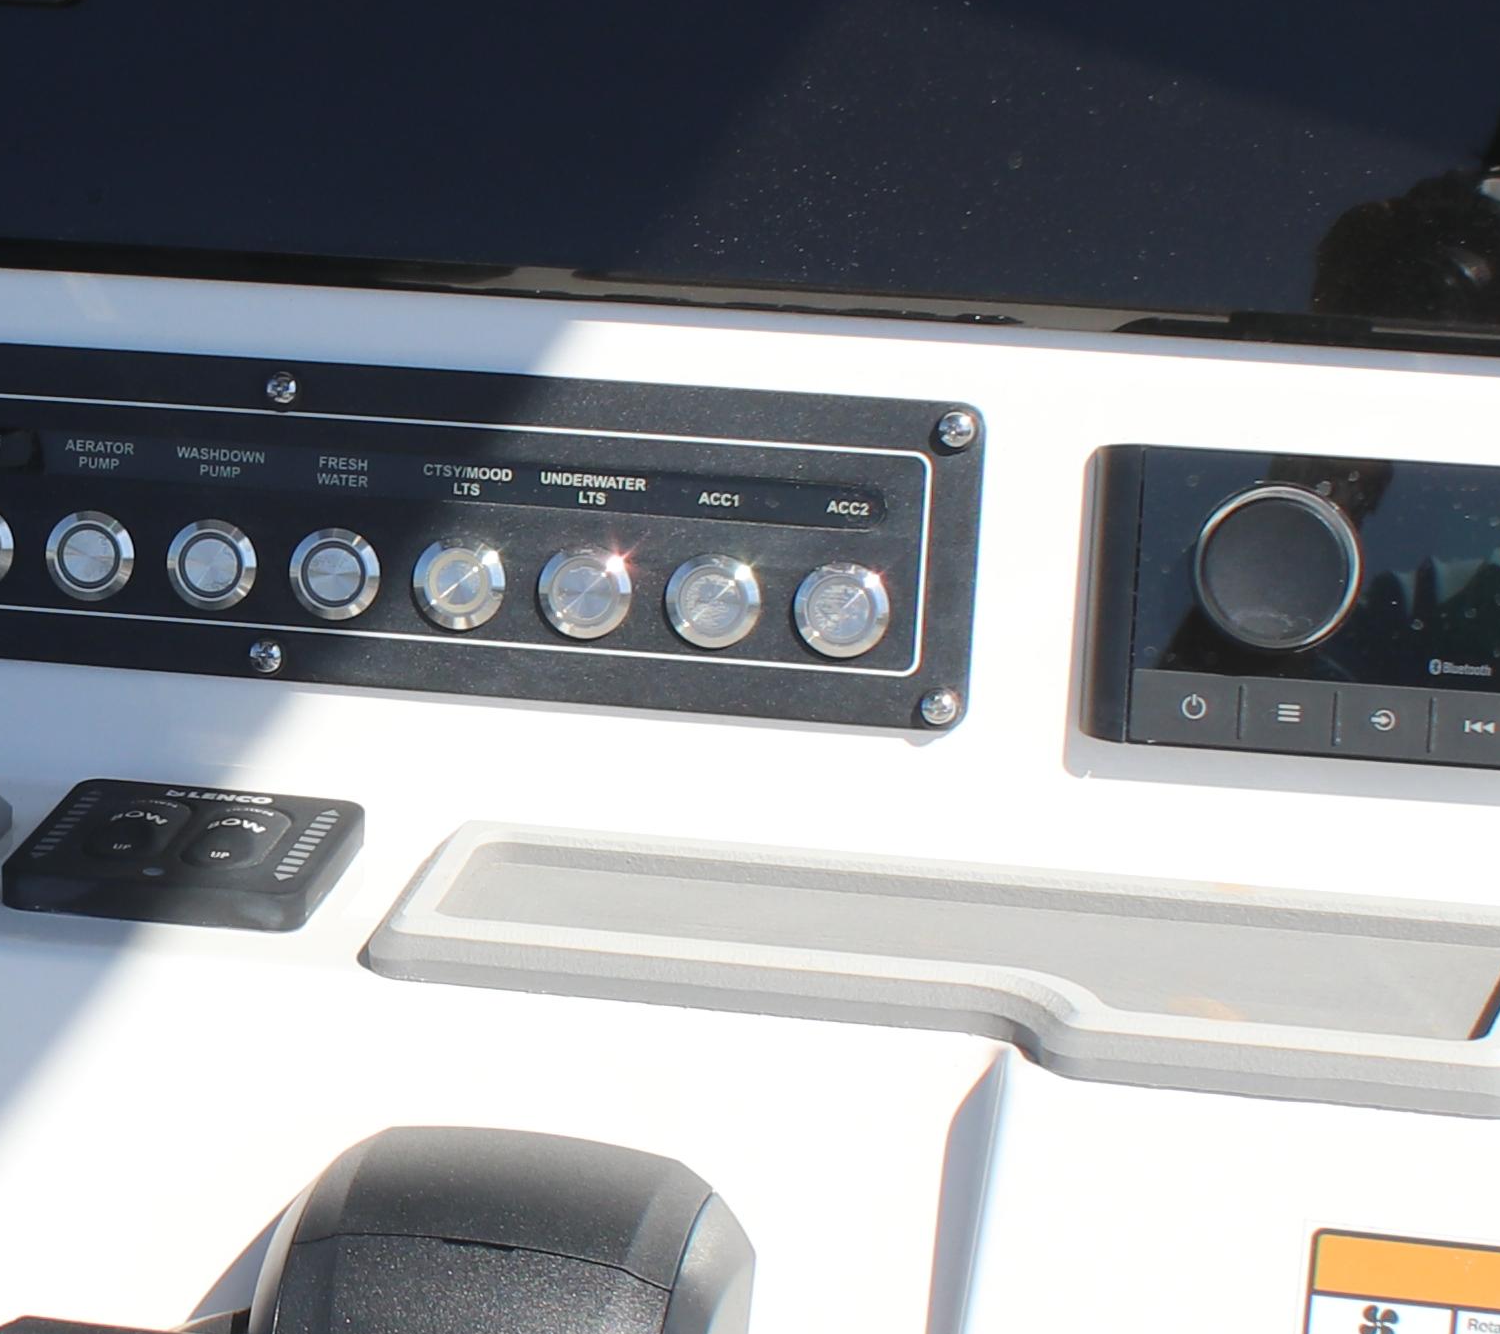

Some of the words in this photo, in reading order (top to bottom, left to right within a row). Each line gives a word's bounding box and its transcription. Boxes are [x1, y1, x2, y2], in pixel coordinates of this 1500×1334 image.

[65, 439, 135, 455] AERATOR
[177, 446, 266, 464] WASHDOWN
[78, 456, 120, 470] PUMP
[200, 464, 241, 478] PUMP
[319, 456, 368, 472] FRESH
[317, 473, 368, 488] WATER
[423, 463, 513, 483] CTSY/MOOD
[453, 482, 481, 497] LTS
[540, 471, 647, 492] UNDERWATER
[578, 491, 607, 506] LTS
[698, 492, 740, 508] ACC1
[826, 500, 869, 516] ACC2
[1442, 661, 1493, 677] Bluetooth
[187, 791, 274, 805] LENCO
[210, 851, 230, 859] UP
